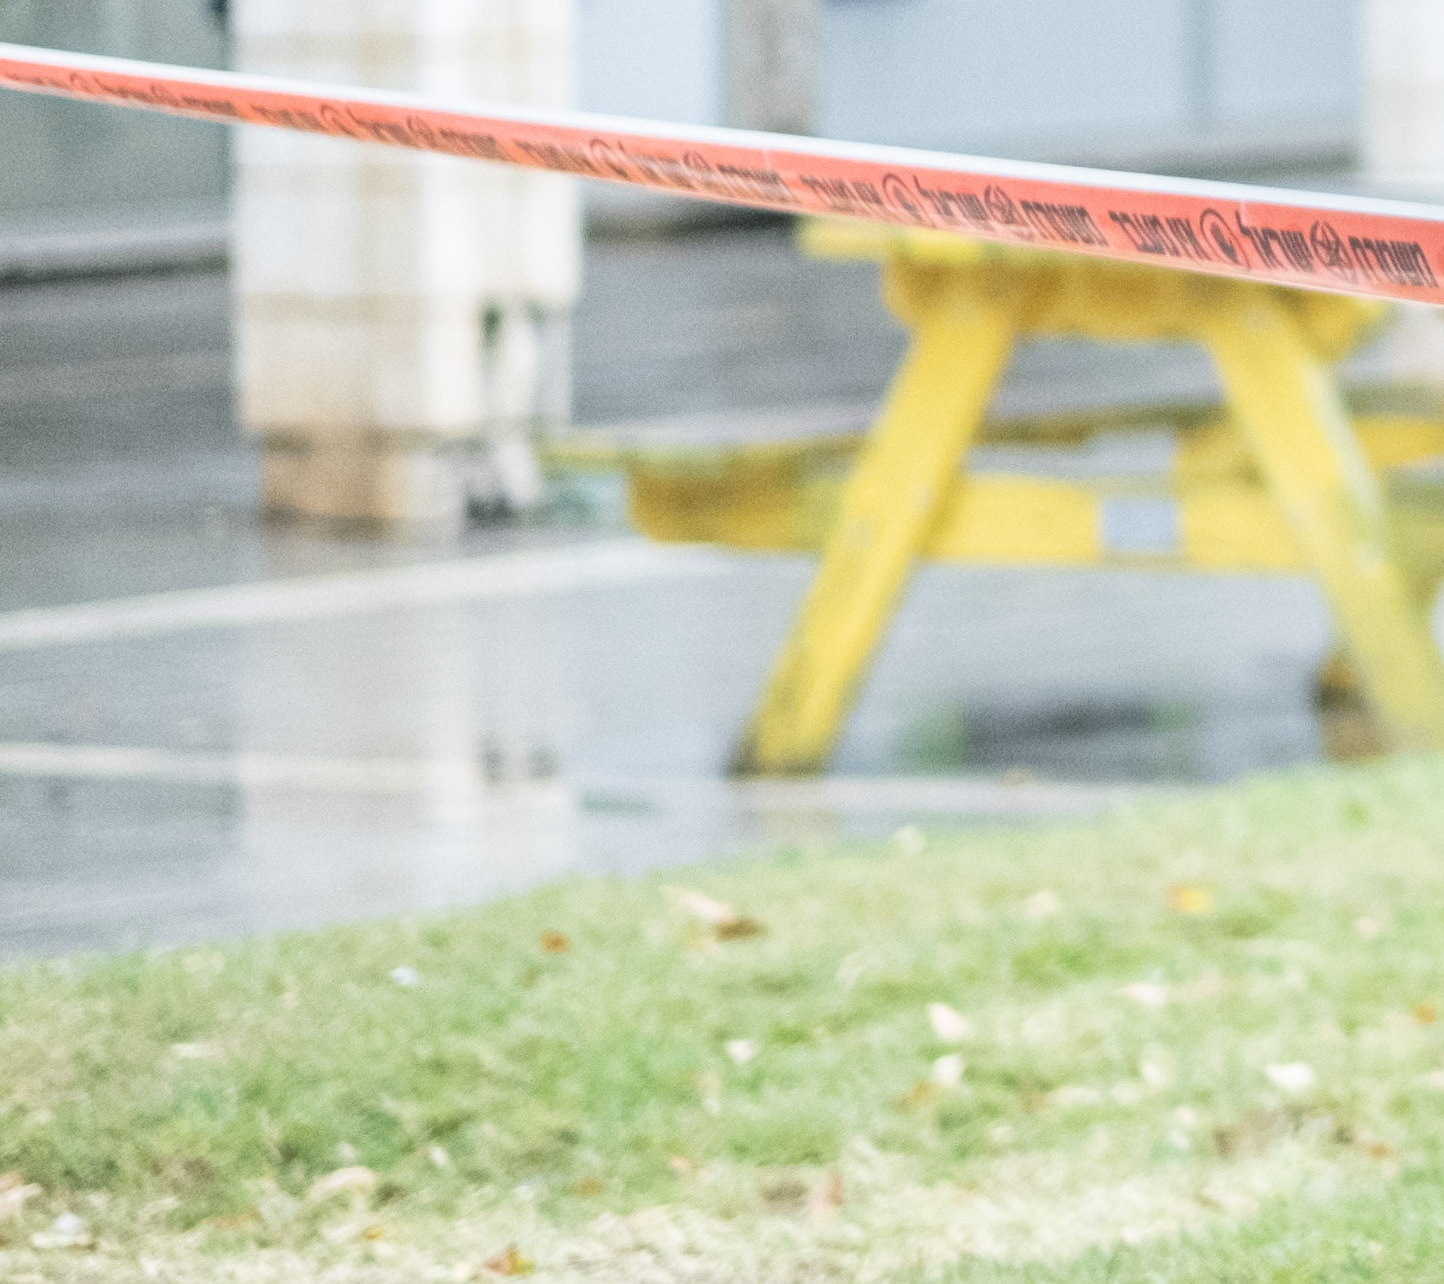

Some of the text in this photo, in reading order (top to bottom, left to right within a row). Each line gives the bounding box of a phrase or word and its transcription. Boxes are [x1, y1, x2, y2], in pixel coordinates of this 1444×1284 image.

[1109, 209, 1438, 287] משטרת ישראל אין מעבר
